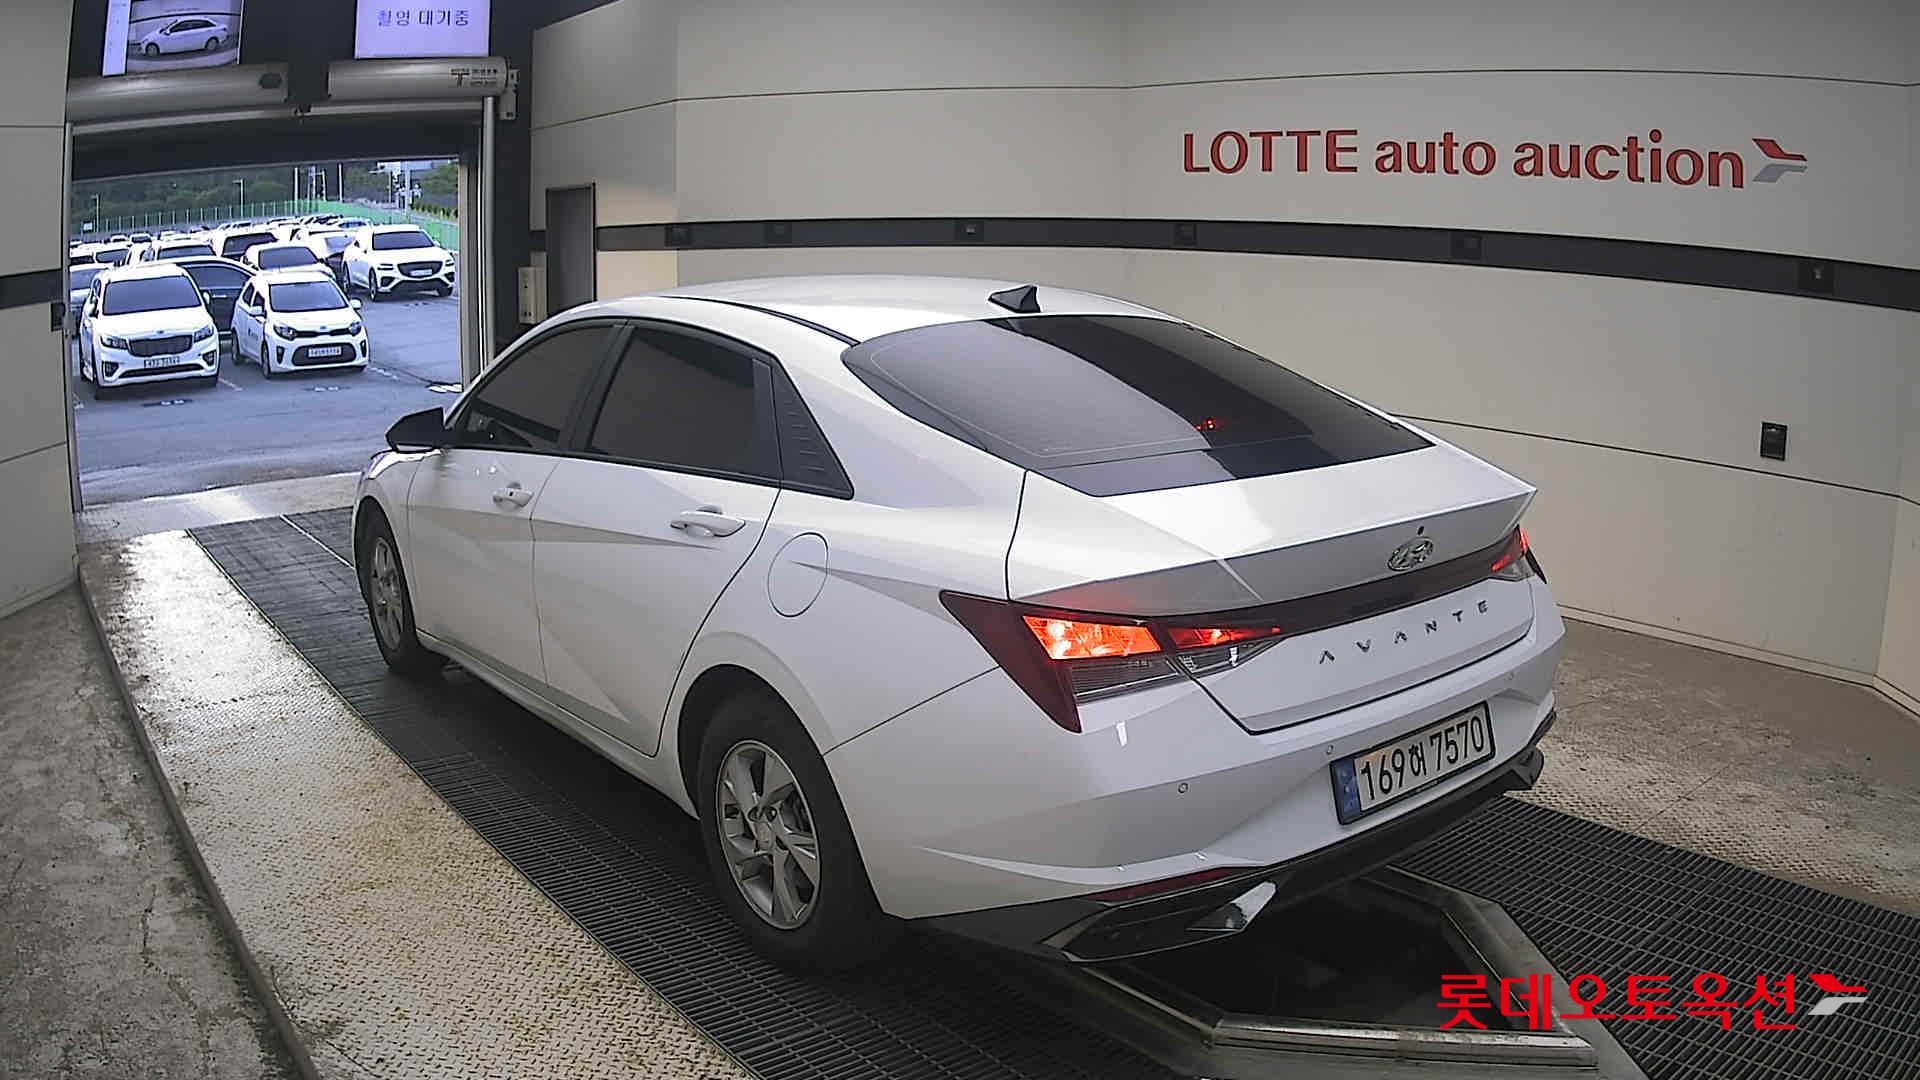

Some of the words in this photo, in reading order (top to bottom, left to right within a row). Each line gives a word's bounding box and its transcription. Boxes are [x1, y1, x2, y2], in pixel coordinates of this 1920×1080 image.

[419, 10, 468, 26] 대기중
[1184, 129, 1358, 173] LOTTE
[1376, 132, 1497, 176] auto
[1514, 129, 1744, 189] auction
[1319, 600, 1488, 664] AVANTE
[1361, 741, 1427, 800] 169허
[1430, 716, 1485, 771] 7570
